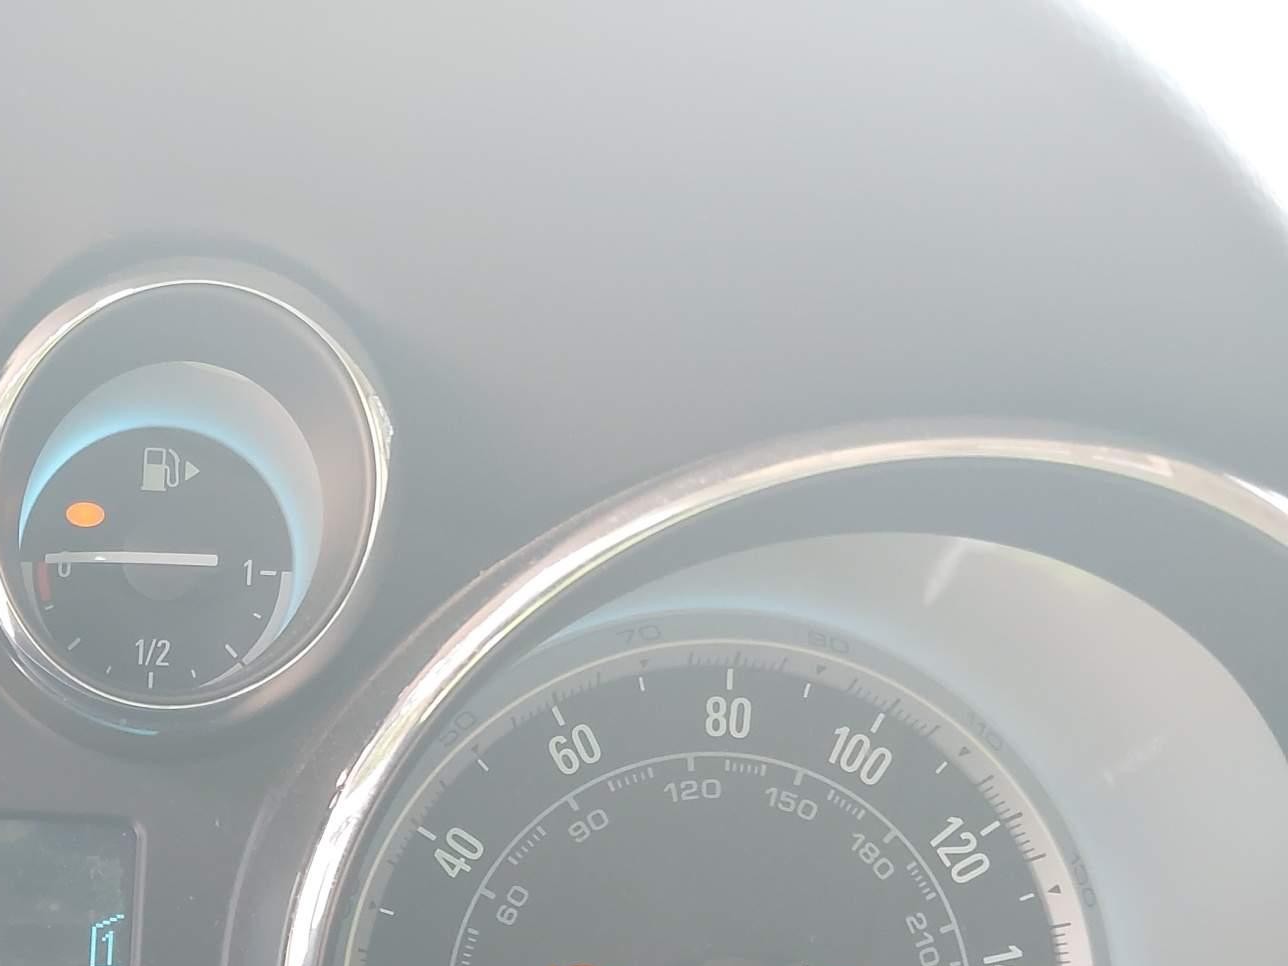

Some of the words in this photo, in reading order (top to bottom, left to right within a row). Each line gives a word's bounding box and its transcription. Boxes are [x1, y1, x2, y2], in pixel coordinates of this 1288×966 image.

[243, 559, 253, 586] 1
[135, 639, 171, 666] 1/2
[705, 696, 752, 738] 80
[548, 723, 602, 775] 60
[828, 725, 893, 786] 100
[663, 779, 722, 803] 120
[765, 786, 819, 821] 150
[567, 808, 609, 843] 90
[434, 826, 485, 878] 40
[851, 831, 895, 880] 180
[929, 815, 991, 883] 120
[496, 885, 529, 926] 60
